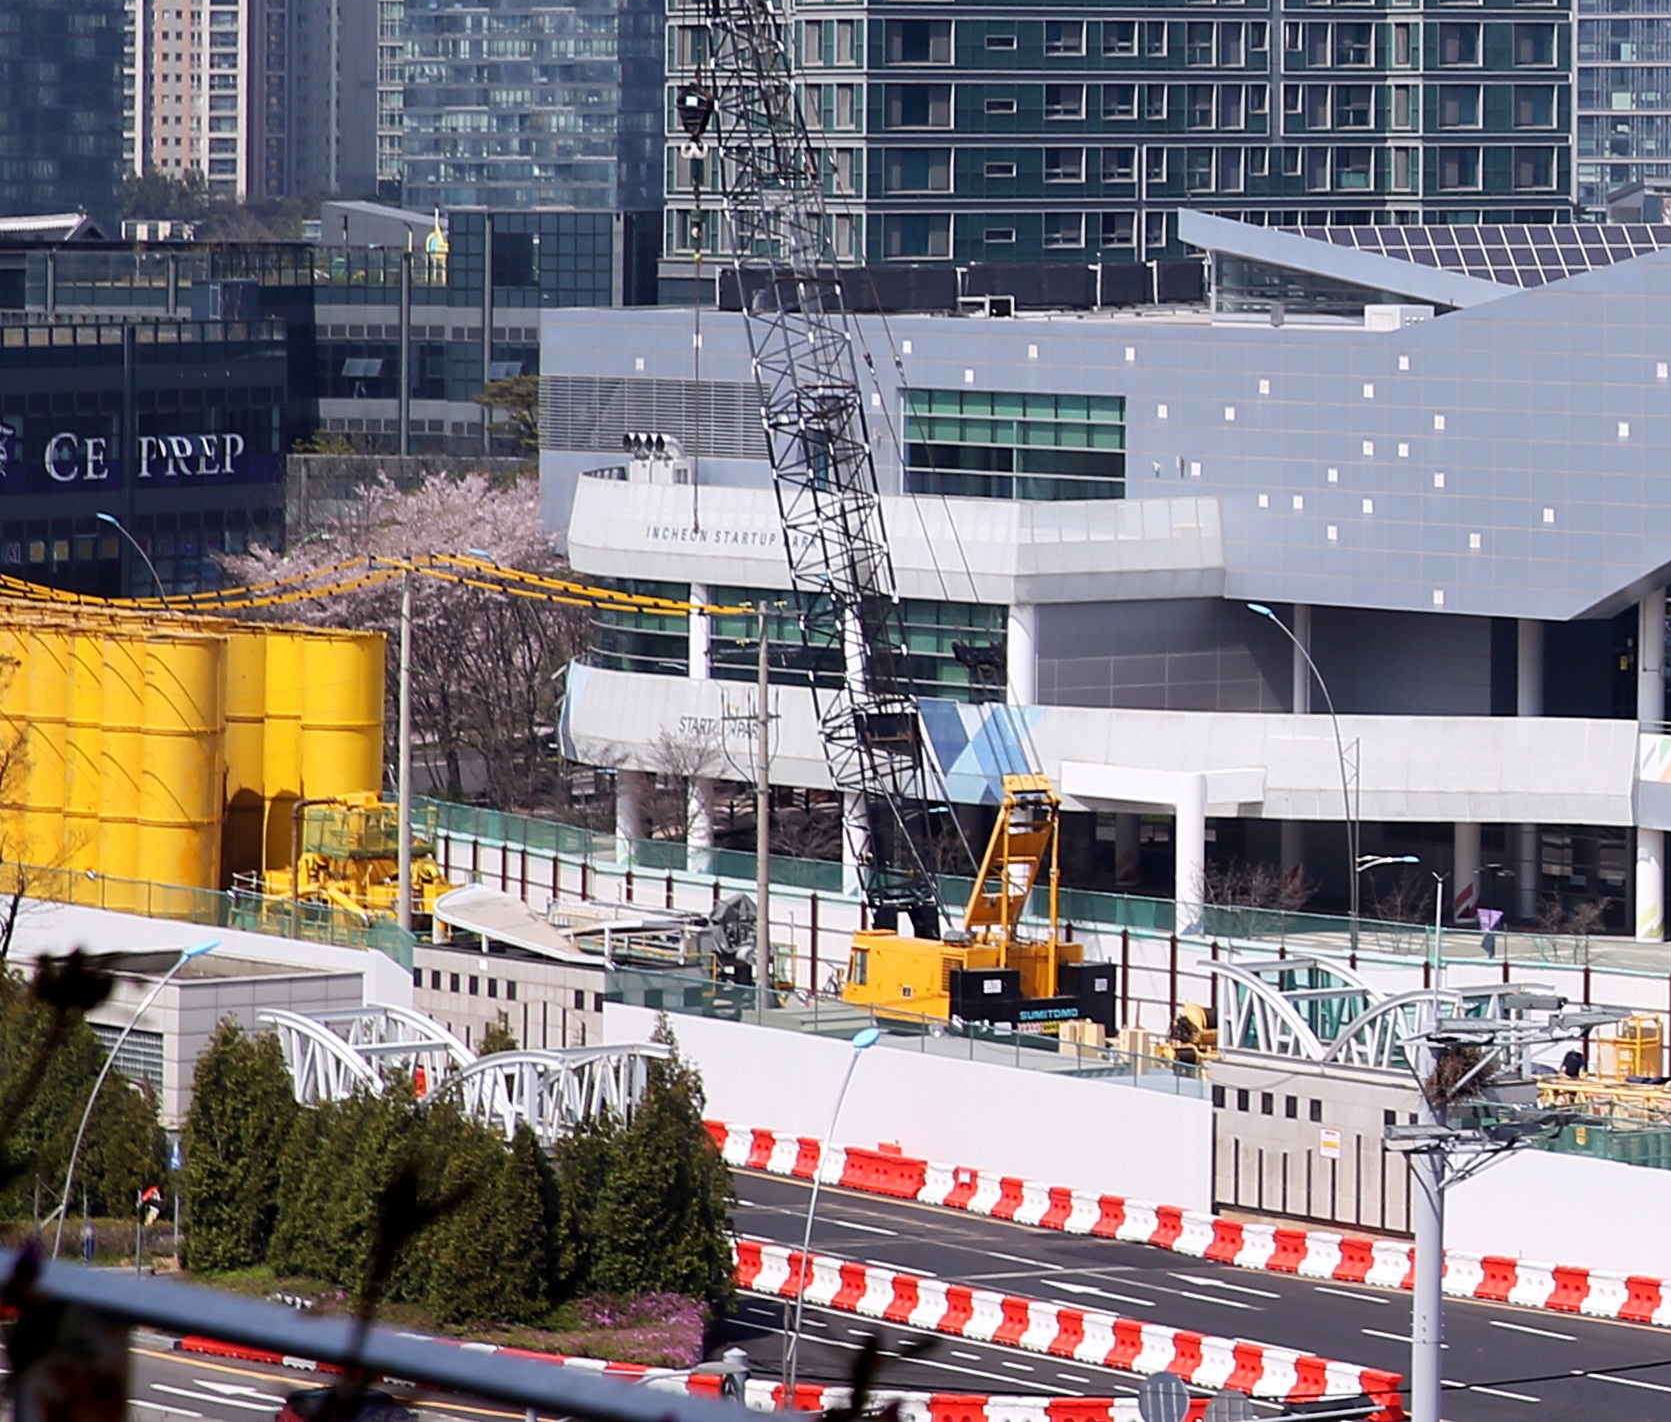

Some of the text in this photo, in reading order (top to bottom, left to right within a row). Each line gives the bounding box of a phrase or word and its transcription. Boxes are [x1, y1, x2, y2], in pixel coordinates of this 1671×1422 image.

[138, 432, 245, 478] PREP
[646, 525, 817, 550] INCHEON STARTUP ARK
[1019, 1008, 1079, 1021] SUMITOMO
